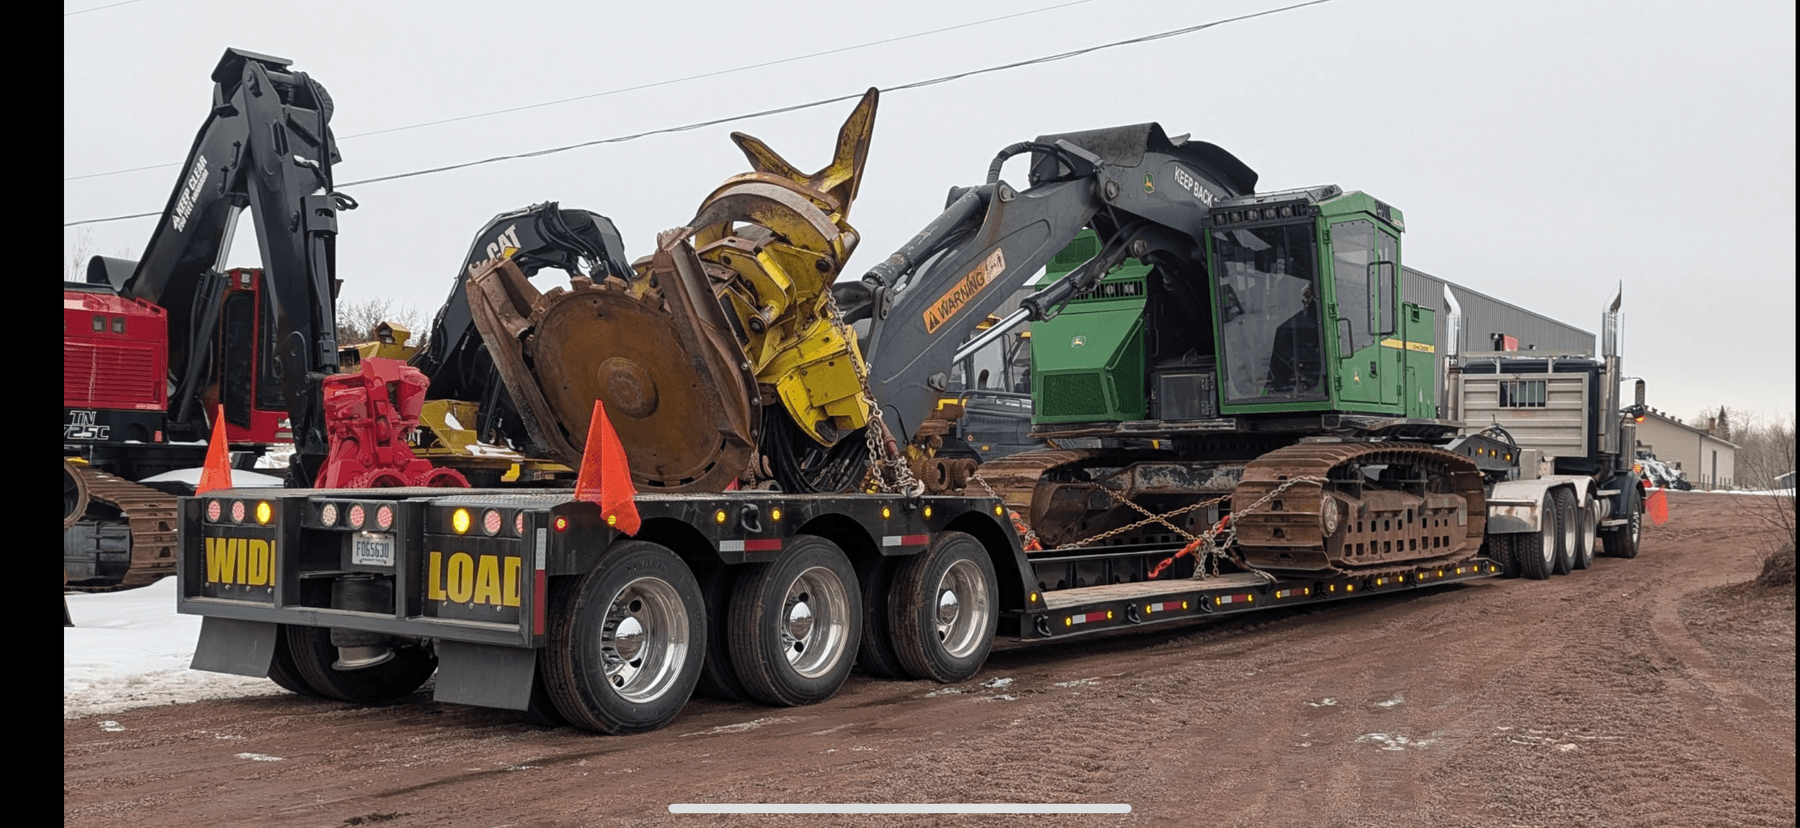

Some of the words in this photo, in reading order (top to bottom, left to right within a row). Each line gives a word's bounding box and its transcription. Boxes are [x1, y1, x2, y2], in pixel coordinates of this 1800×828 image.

[175, 187, 191, 217] KEEP
[188, 154, 208, 191] CLEAR
[1174, 165, 1194, 192] KEEP
[1193, 180, 1214, 208] BACK
[183, 200, 194, 219] FEET
[486, 222, 522, 260] CAT
[937, 271, 985, 320] WARNING
[69, 410, 97, 426] TN
[404, 428, 423, 446] AT
[428, 551, 522, 607] LOAD
